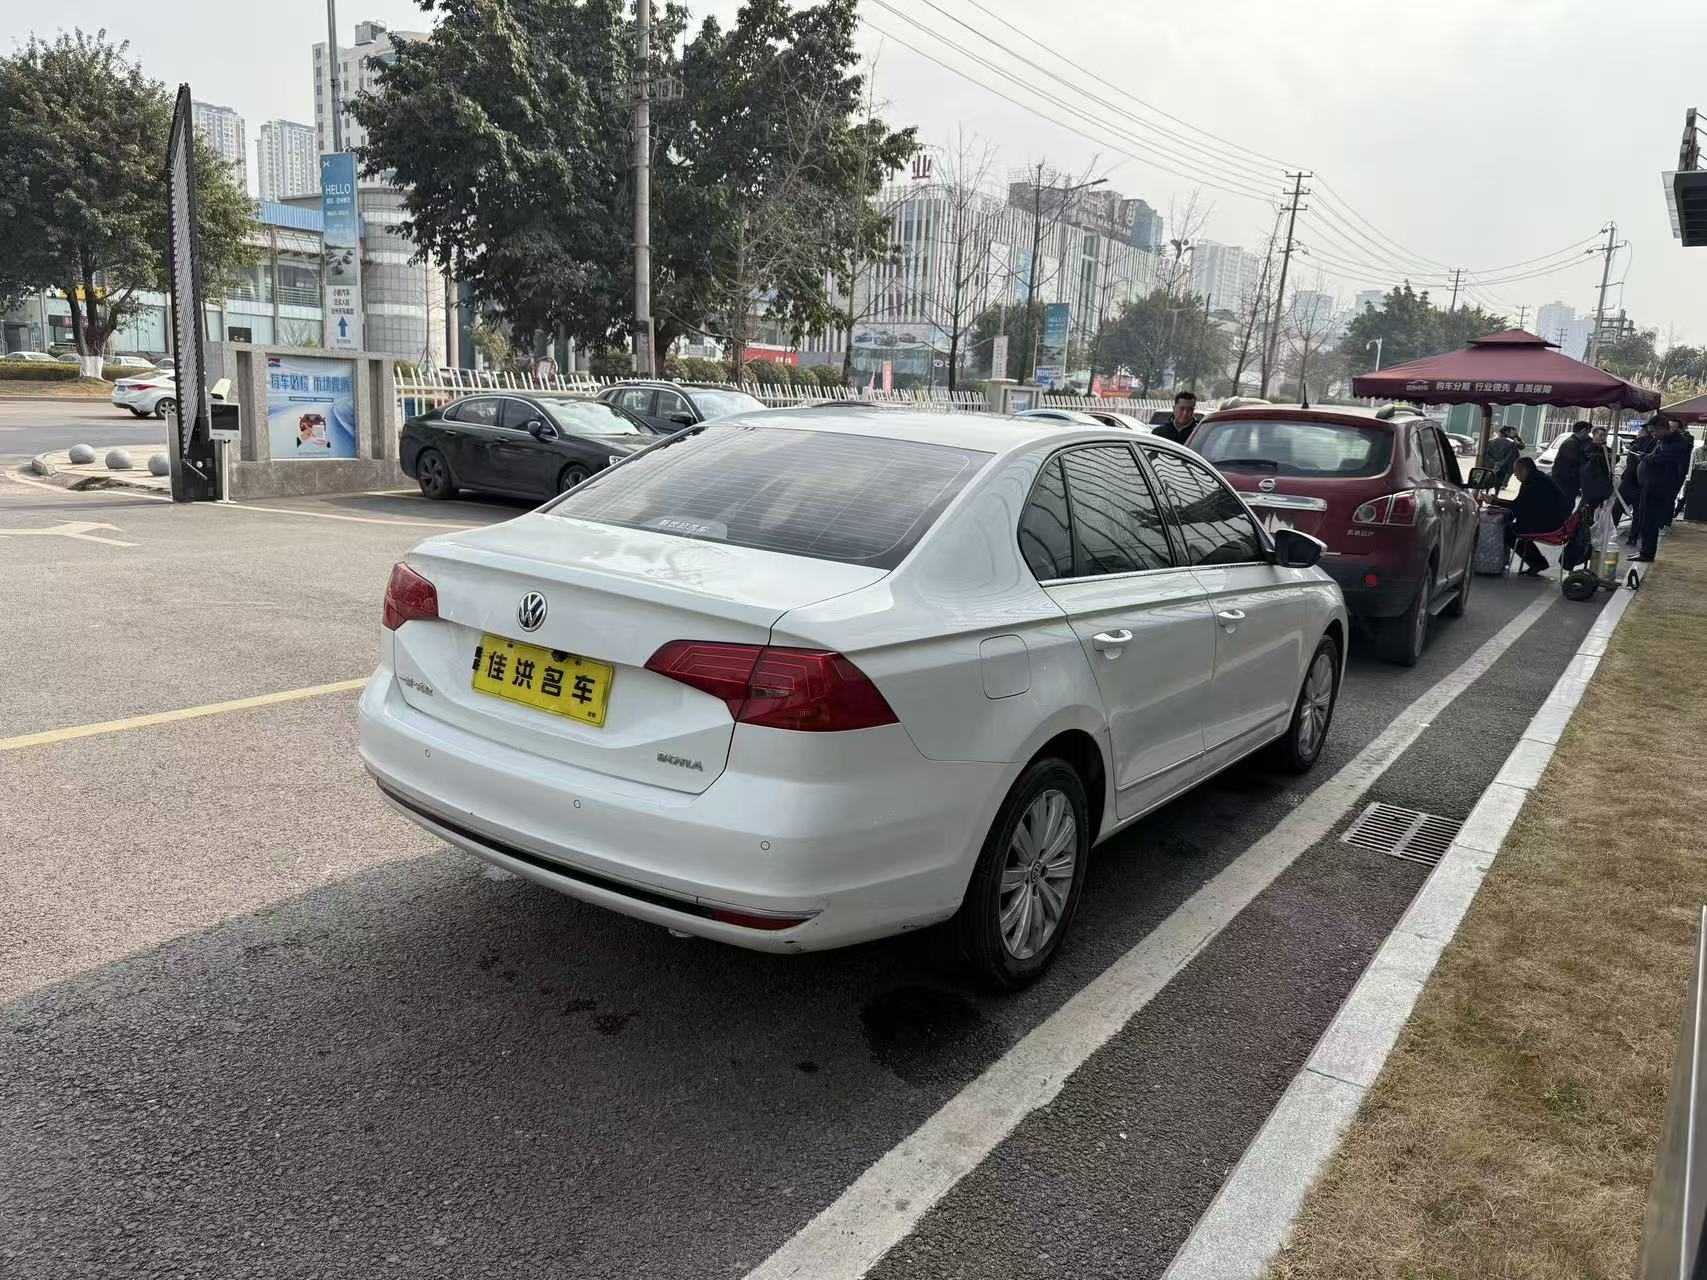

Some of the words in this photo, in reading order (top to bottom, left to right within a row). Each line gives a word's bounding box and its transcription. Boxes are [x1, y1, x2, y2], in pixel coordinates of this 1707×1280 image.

[325, 183, 351, 195] HELLO
[1475, 382, 1511, 393] 行业领先
[488, 651, 596, 705] 佳洪名车
